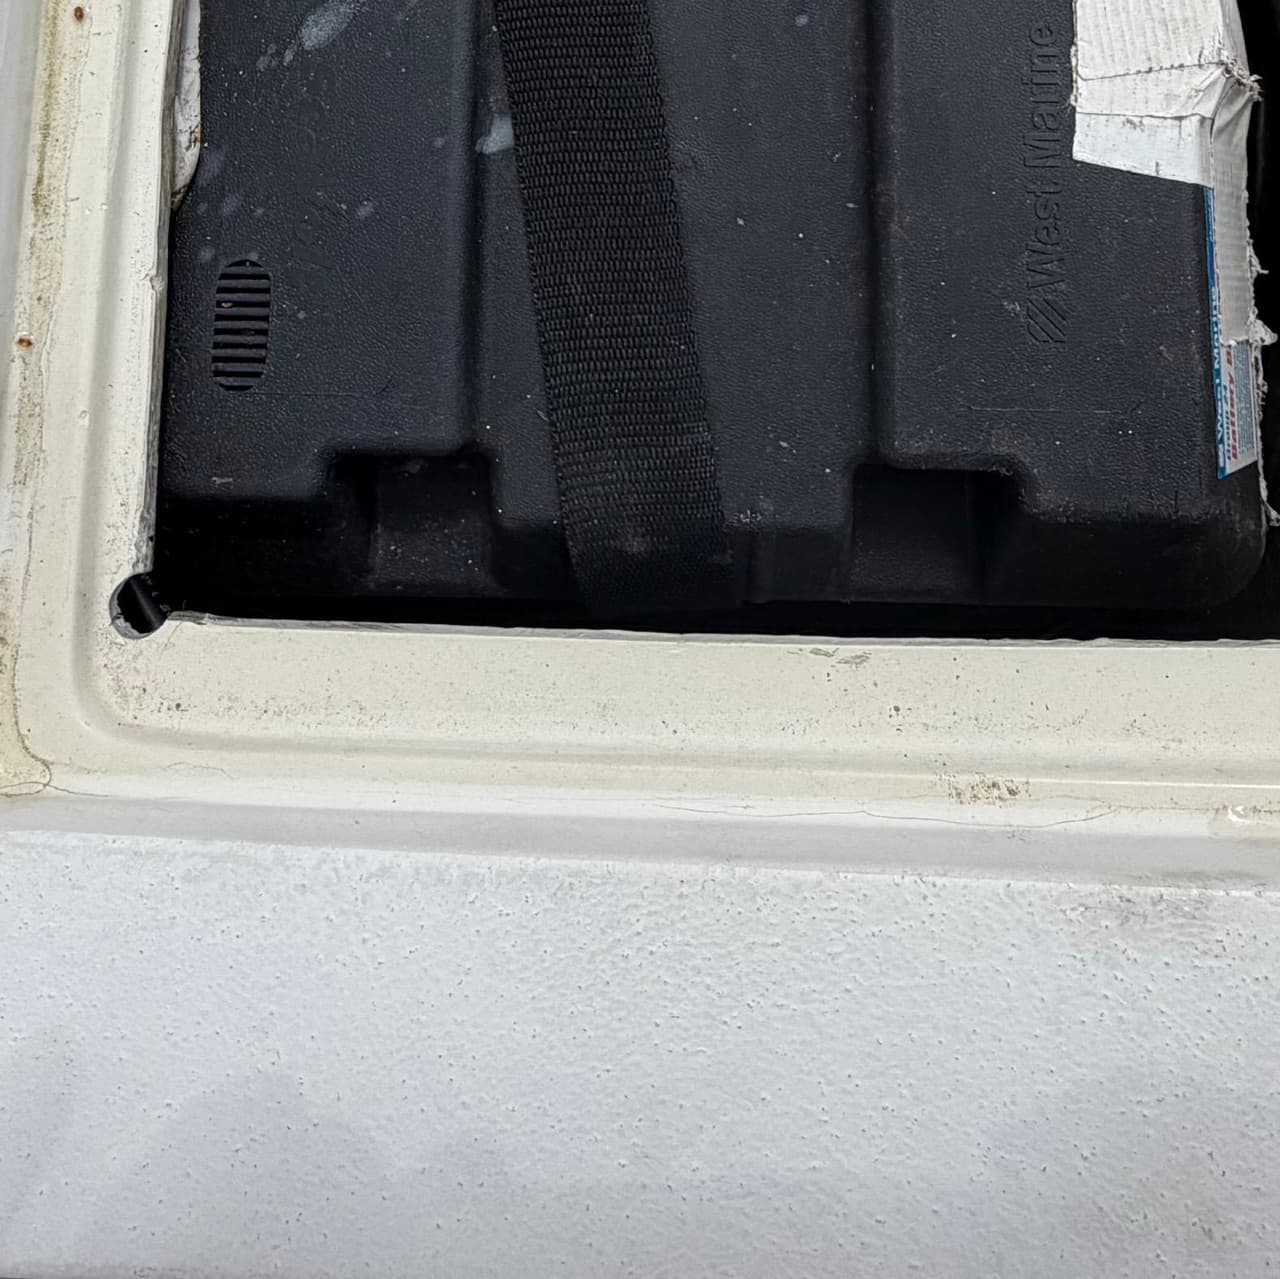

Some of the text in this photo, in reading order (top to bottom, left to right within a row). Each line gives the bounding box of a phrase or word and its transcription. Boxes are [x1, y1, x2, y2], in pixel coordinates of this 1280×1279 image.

[1021, 22, 1067, 290] West Marine
[1228, 372, 1238, 460] Battery
